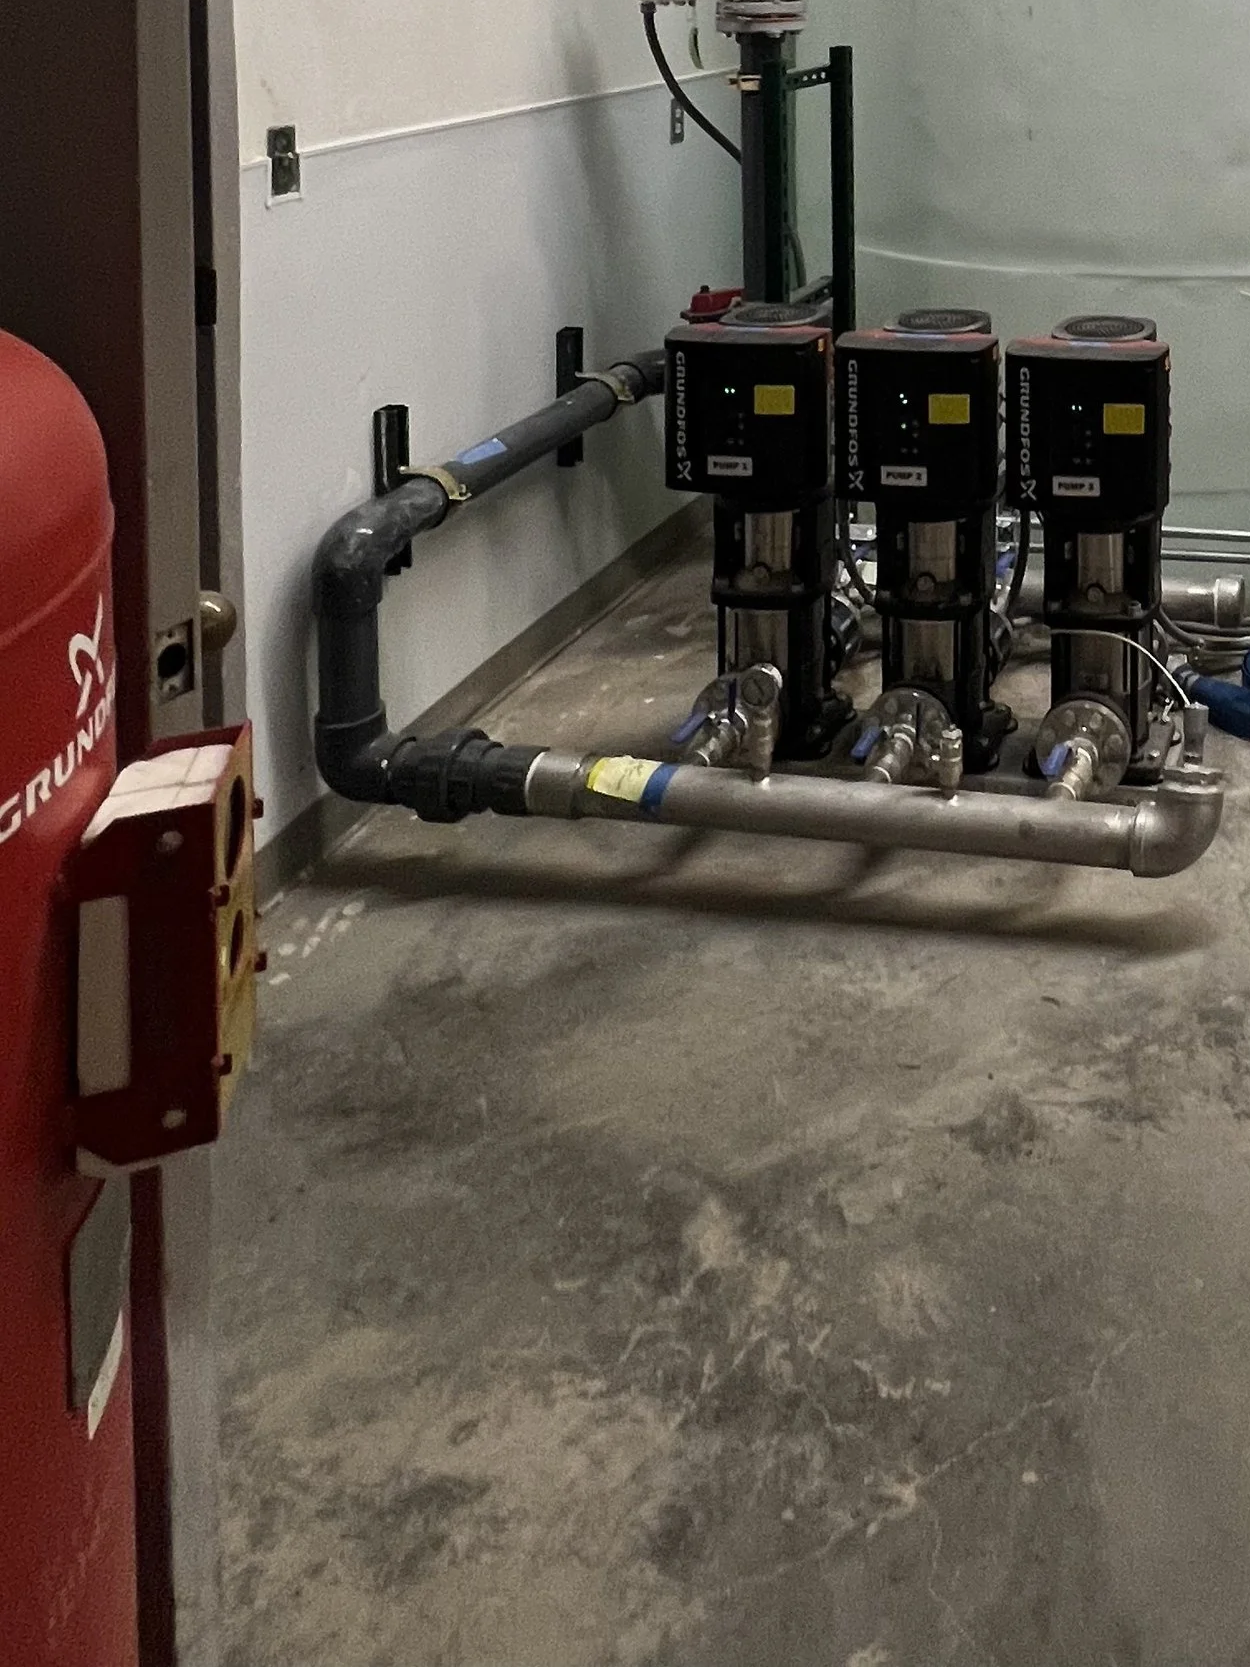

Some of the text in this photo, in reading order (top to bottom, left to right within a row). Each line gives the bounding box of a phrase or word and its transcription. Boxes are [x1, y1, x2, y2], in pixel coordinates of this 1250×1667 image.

[676, 351, 687, 458] GRUNDFOS
[848, 359, 858, 467] GRUNDFOS
[1020, 367, 1030, 476] GRUNDFOS
[712, 461, 740, 470] PUMP
[886, 471, 913, 480] PUMP
[1058, 482, 1086, 490] PUMP
